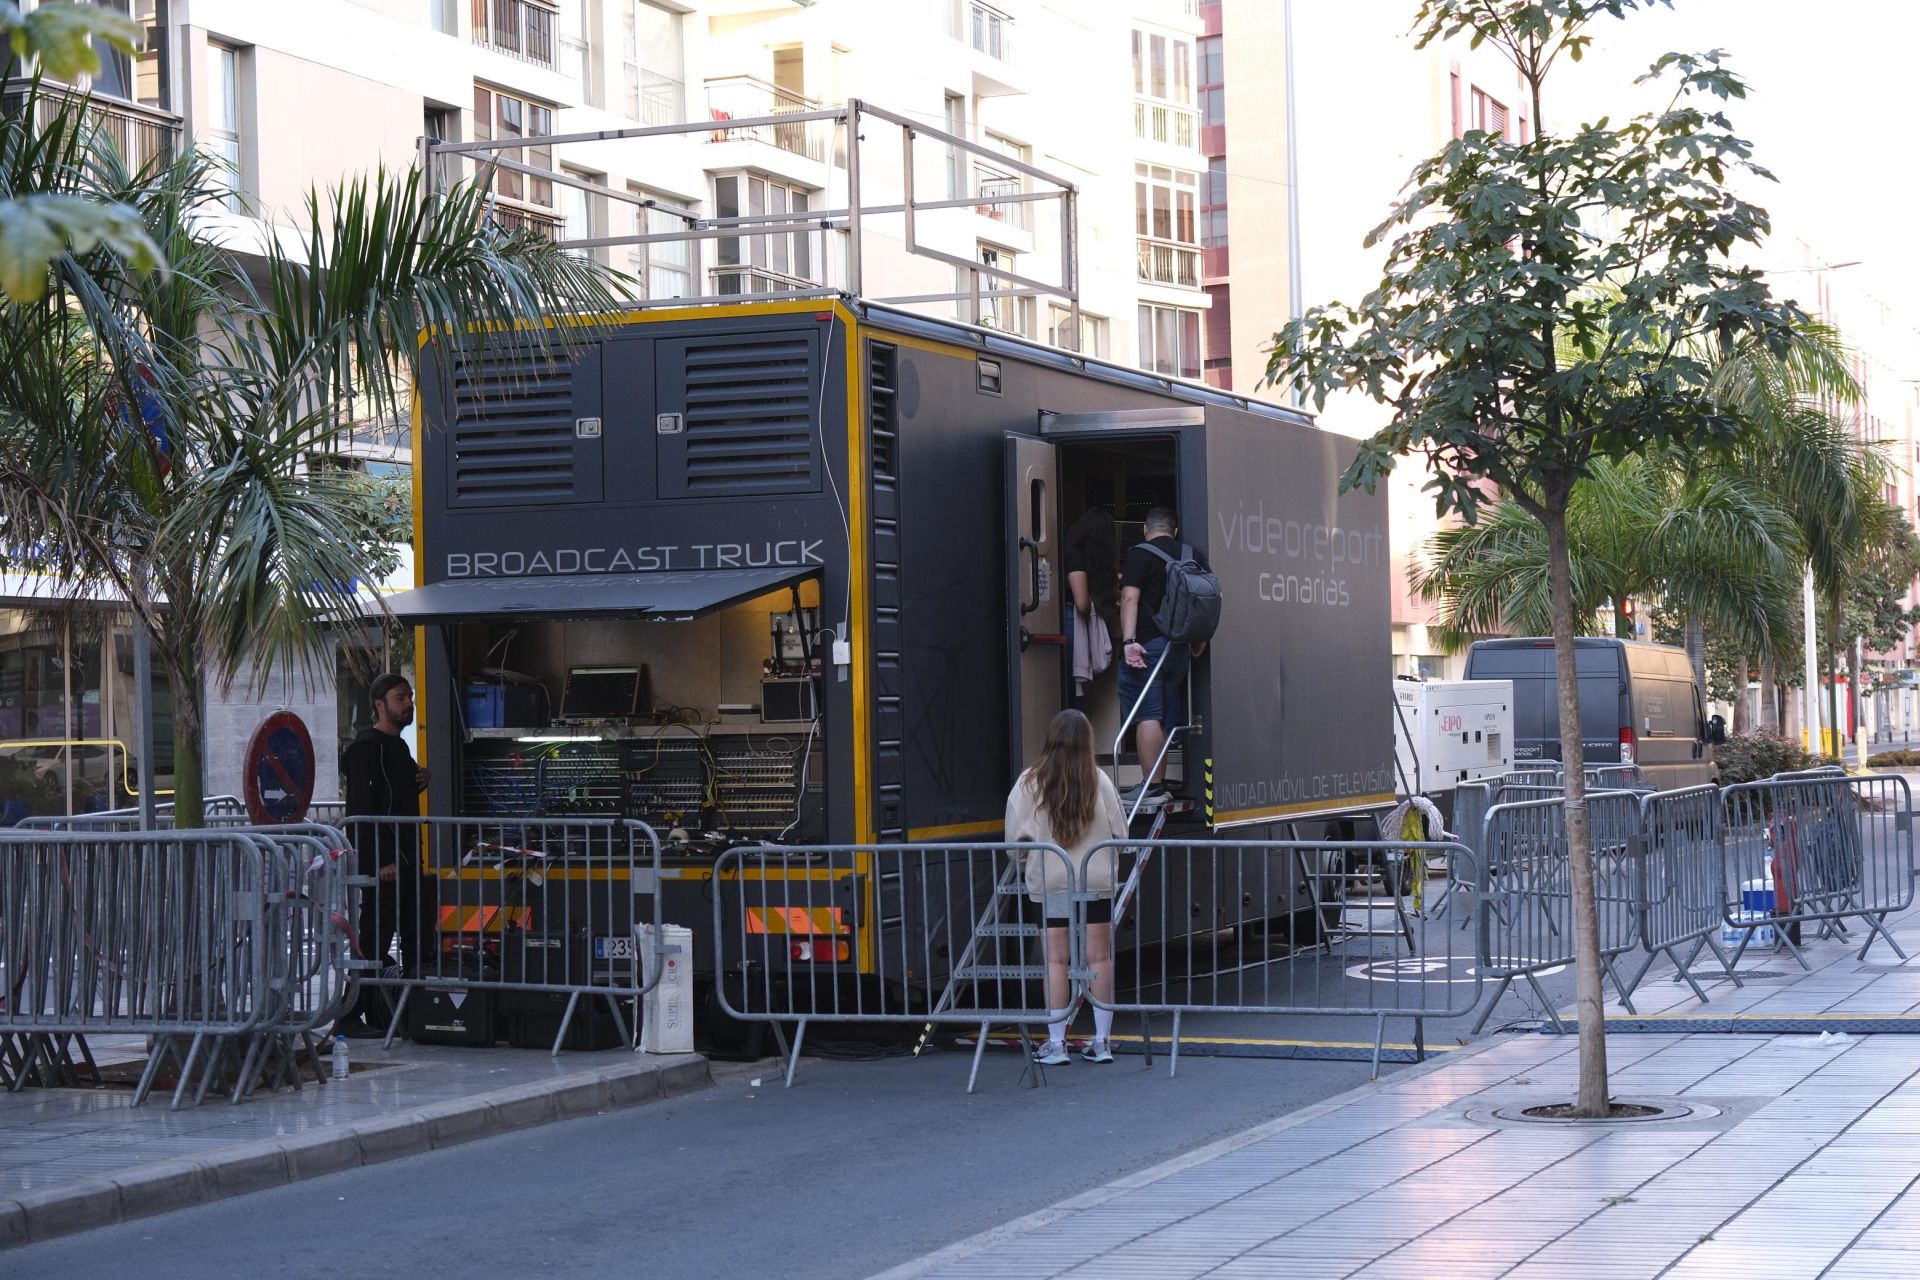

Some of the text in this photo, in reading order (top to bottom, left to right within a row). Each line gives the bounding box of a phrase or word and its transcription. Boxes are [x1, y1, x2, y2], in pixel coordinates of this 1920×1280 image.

[1218, 499, 1382, 573] videoreport
[447, 539, 824, 577] BROADCAST TRUCK
[1259, 569, 1350, 606] canarias
[1215, 762, 1395, 808] UNIDAD MÓVIL DE TELEVISIÓN
